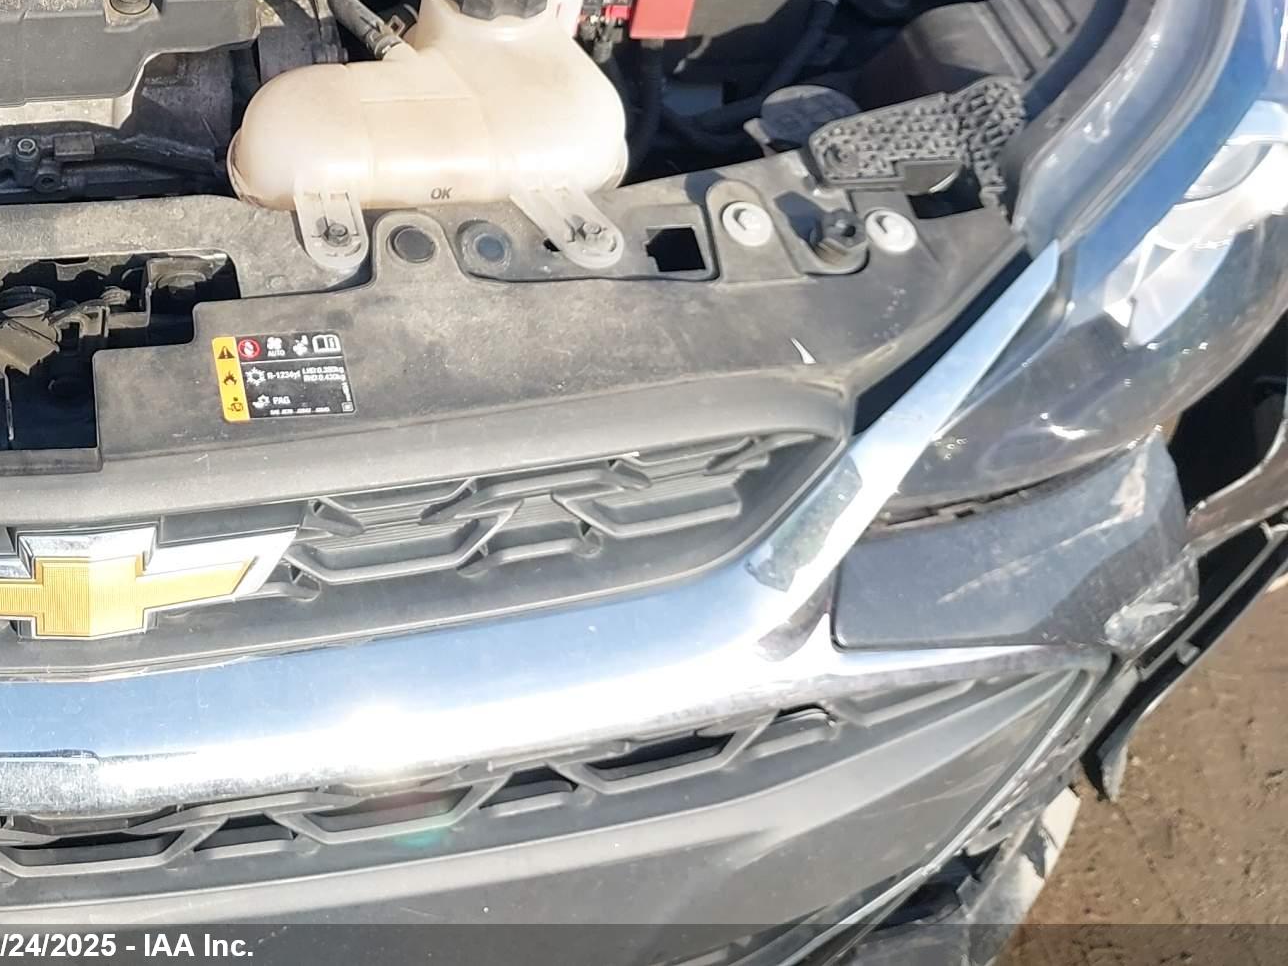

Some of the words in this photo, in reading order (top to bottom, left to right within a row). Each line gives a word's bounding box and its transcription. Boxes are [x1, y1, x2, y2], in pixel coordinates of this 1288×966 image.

[431, 187, 453, 200] OK
[267, 349, 286, 357] AUTO
[272, 396, 291, 405] PAG
